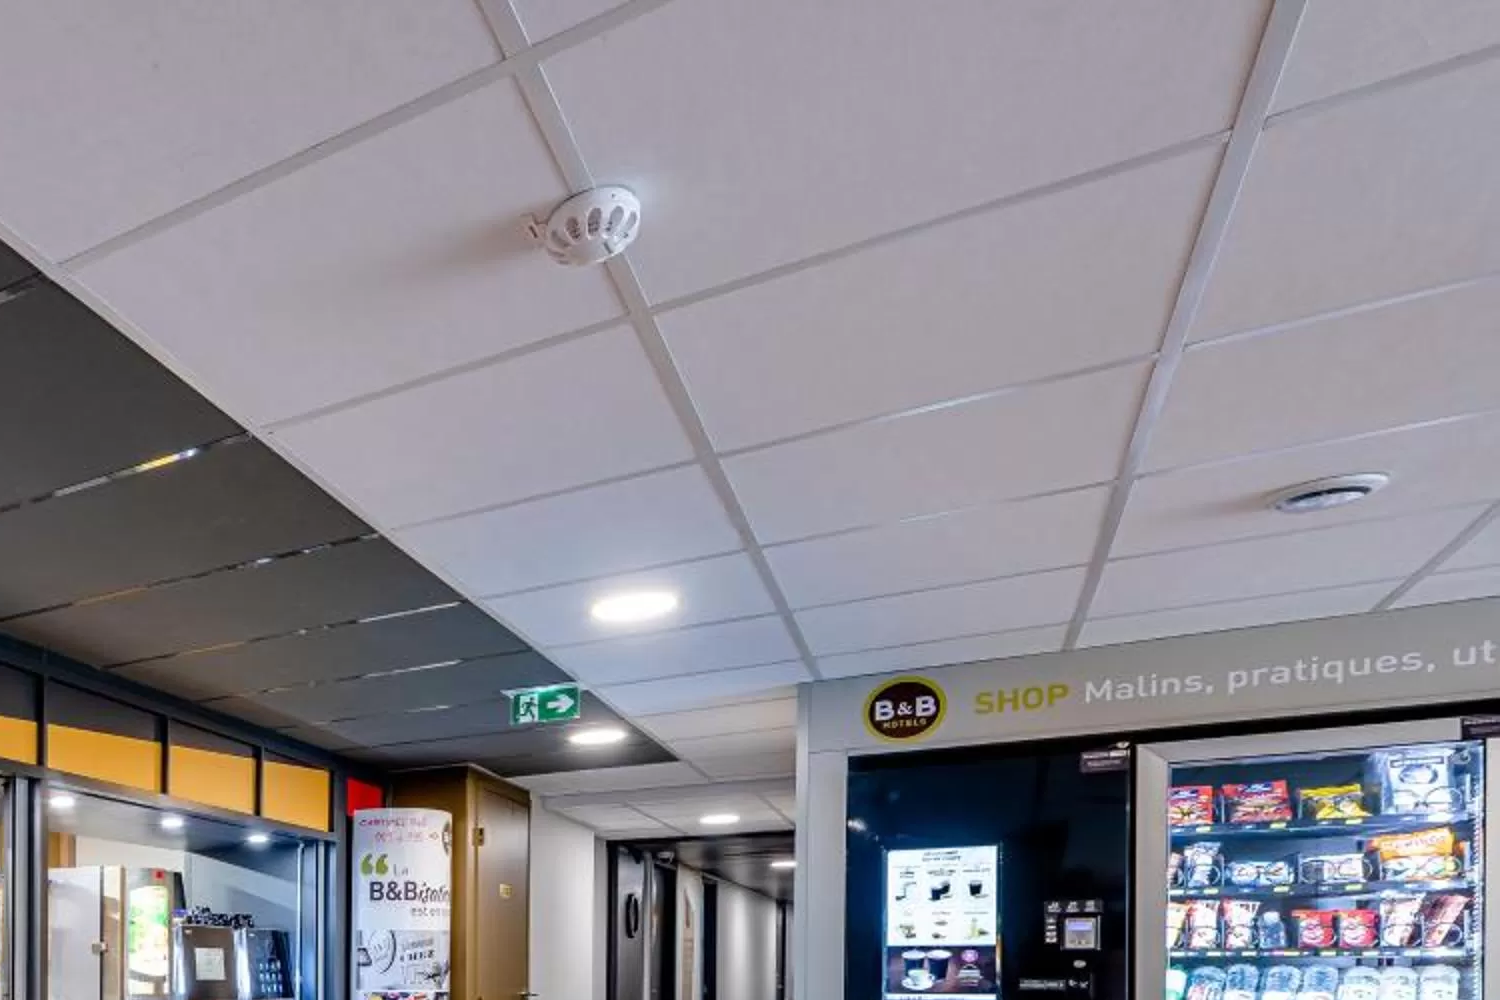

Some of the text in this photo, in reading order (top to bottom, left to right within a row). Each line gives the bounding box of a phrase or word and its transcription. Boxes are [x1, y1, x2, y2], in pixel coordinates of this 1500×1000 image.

[973, 640, 1497, 714] SHOP Malins, pratiques, ut
[874, 695, 937, 721] B&B
